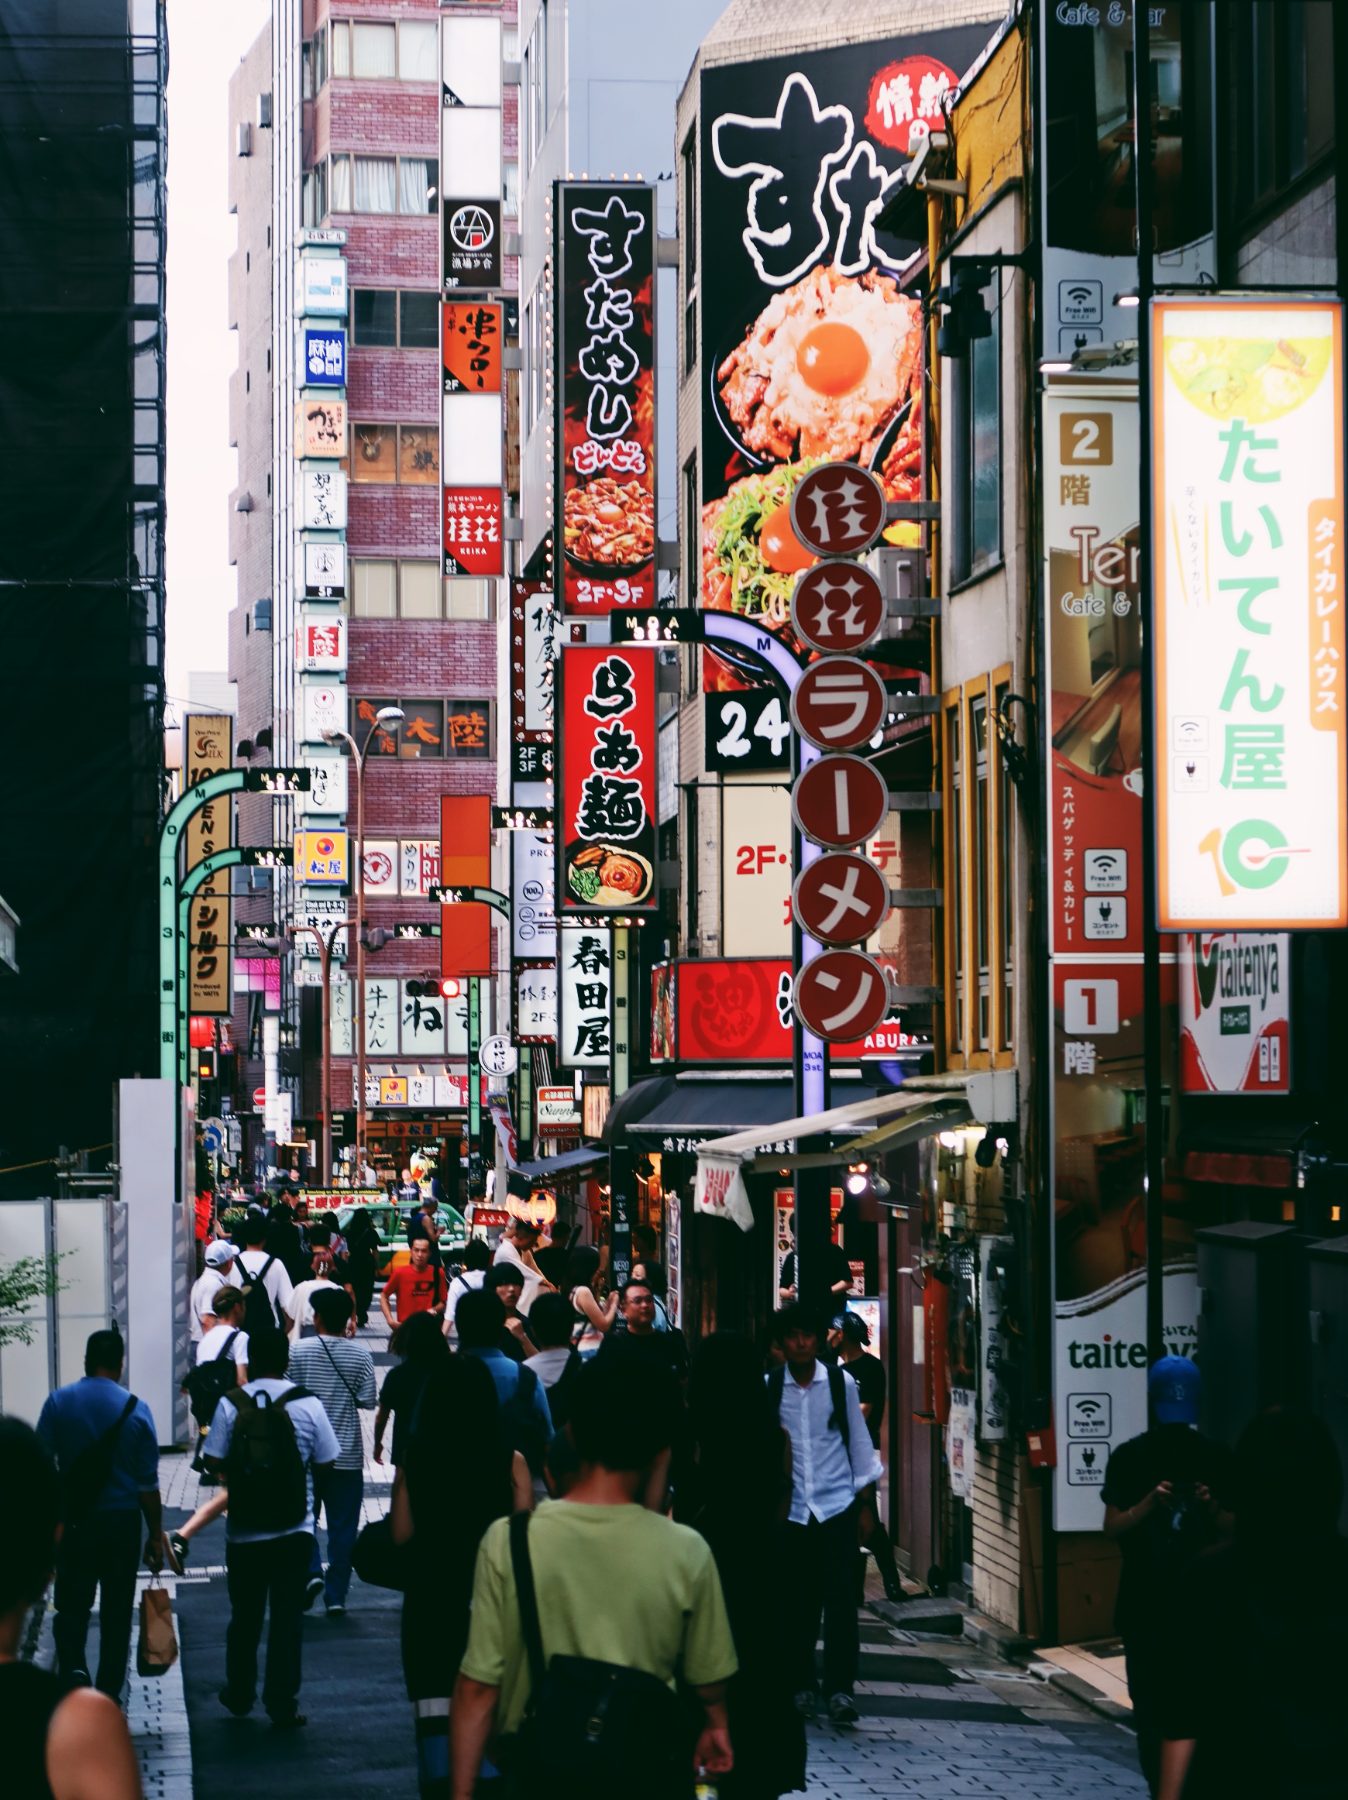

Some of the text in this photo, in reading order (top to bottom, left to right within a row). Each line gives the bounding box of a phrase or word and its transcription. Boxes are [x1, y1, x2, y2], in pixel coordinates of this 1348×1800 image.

[1056, 3, 1166, 26] Cafe & ar
[446, 277, 459, 287] 3F
[572, 196, 645, 441] すためし
[445, 379, 459, 390] 2F
[1072, 421, 1099, 459] 2
[573, 440, 646, 475] どんどん
[1060, 474, 1090, 507] 階
[447, 502, 499, 513] 熊本ラーメン
[448, 515, 499, 542] 桂花
[445, 558, 456, 567] B1
[460, 547, 487, 555] KEIKA
[1061, 592, 1132, 616] Cafe &
[1218, 419, 1288, 791] たいてん屋
[1313, 517, 1339, 714] タイカレーハウス
[405, 711, 487, 749] 大陸
[519, 747, 537, 758] 2F
[574, 654, 647, 841] らぁ麺
[519, 761, 537, 772] 3F
[310, 861, 341, 874] 松屋
[196, 905, 218, 980] シルク
[1220, 942, 1279, 1011] taitenya
[572, 936, 609, 1058] 春田屋
[1080, 988, 1098, 1025] 1
[365, 985, 388, 1049] 牛たん
[803, 1051, 823, 1060] MOA
[1064, 1042, 1096, 1076] 階
[539, 1103, 575, 1121] Sunny
